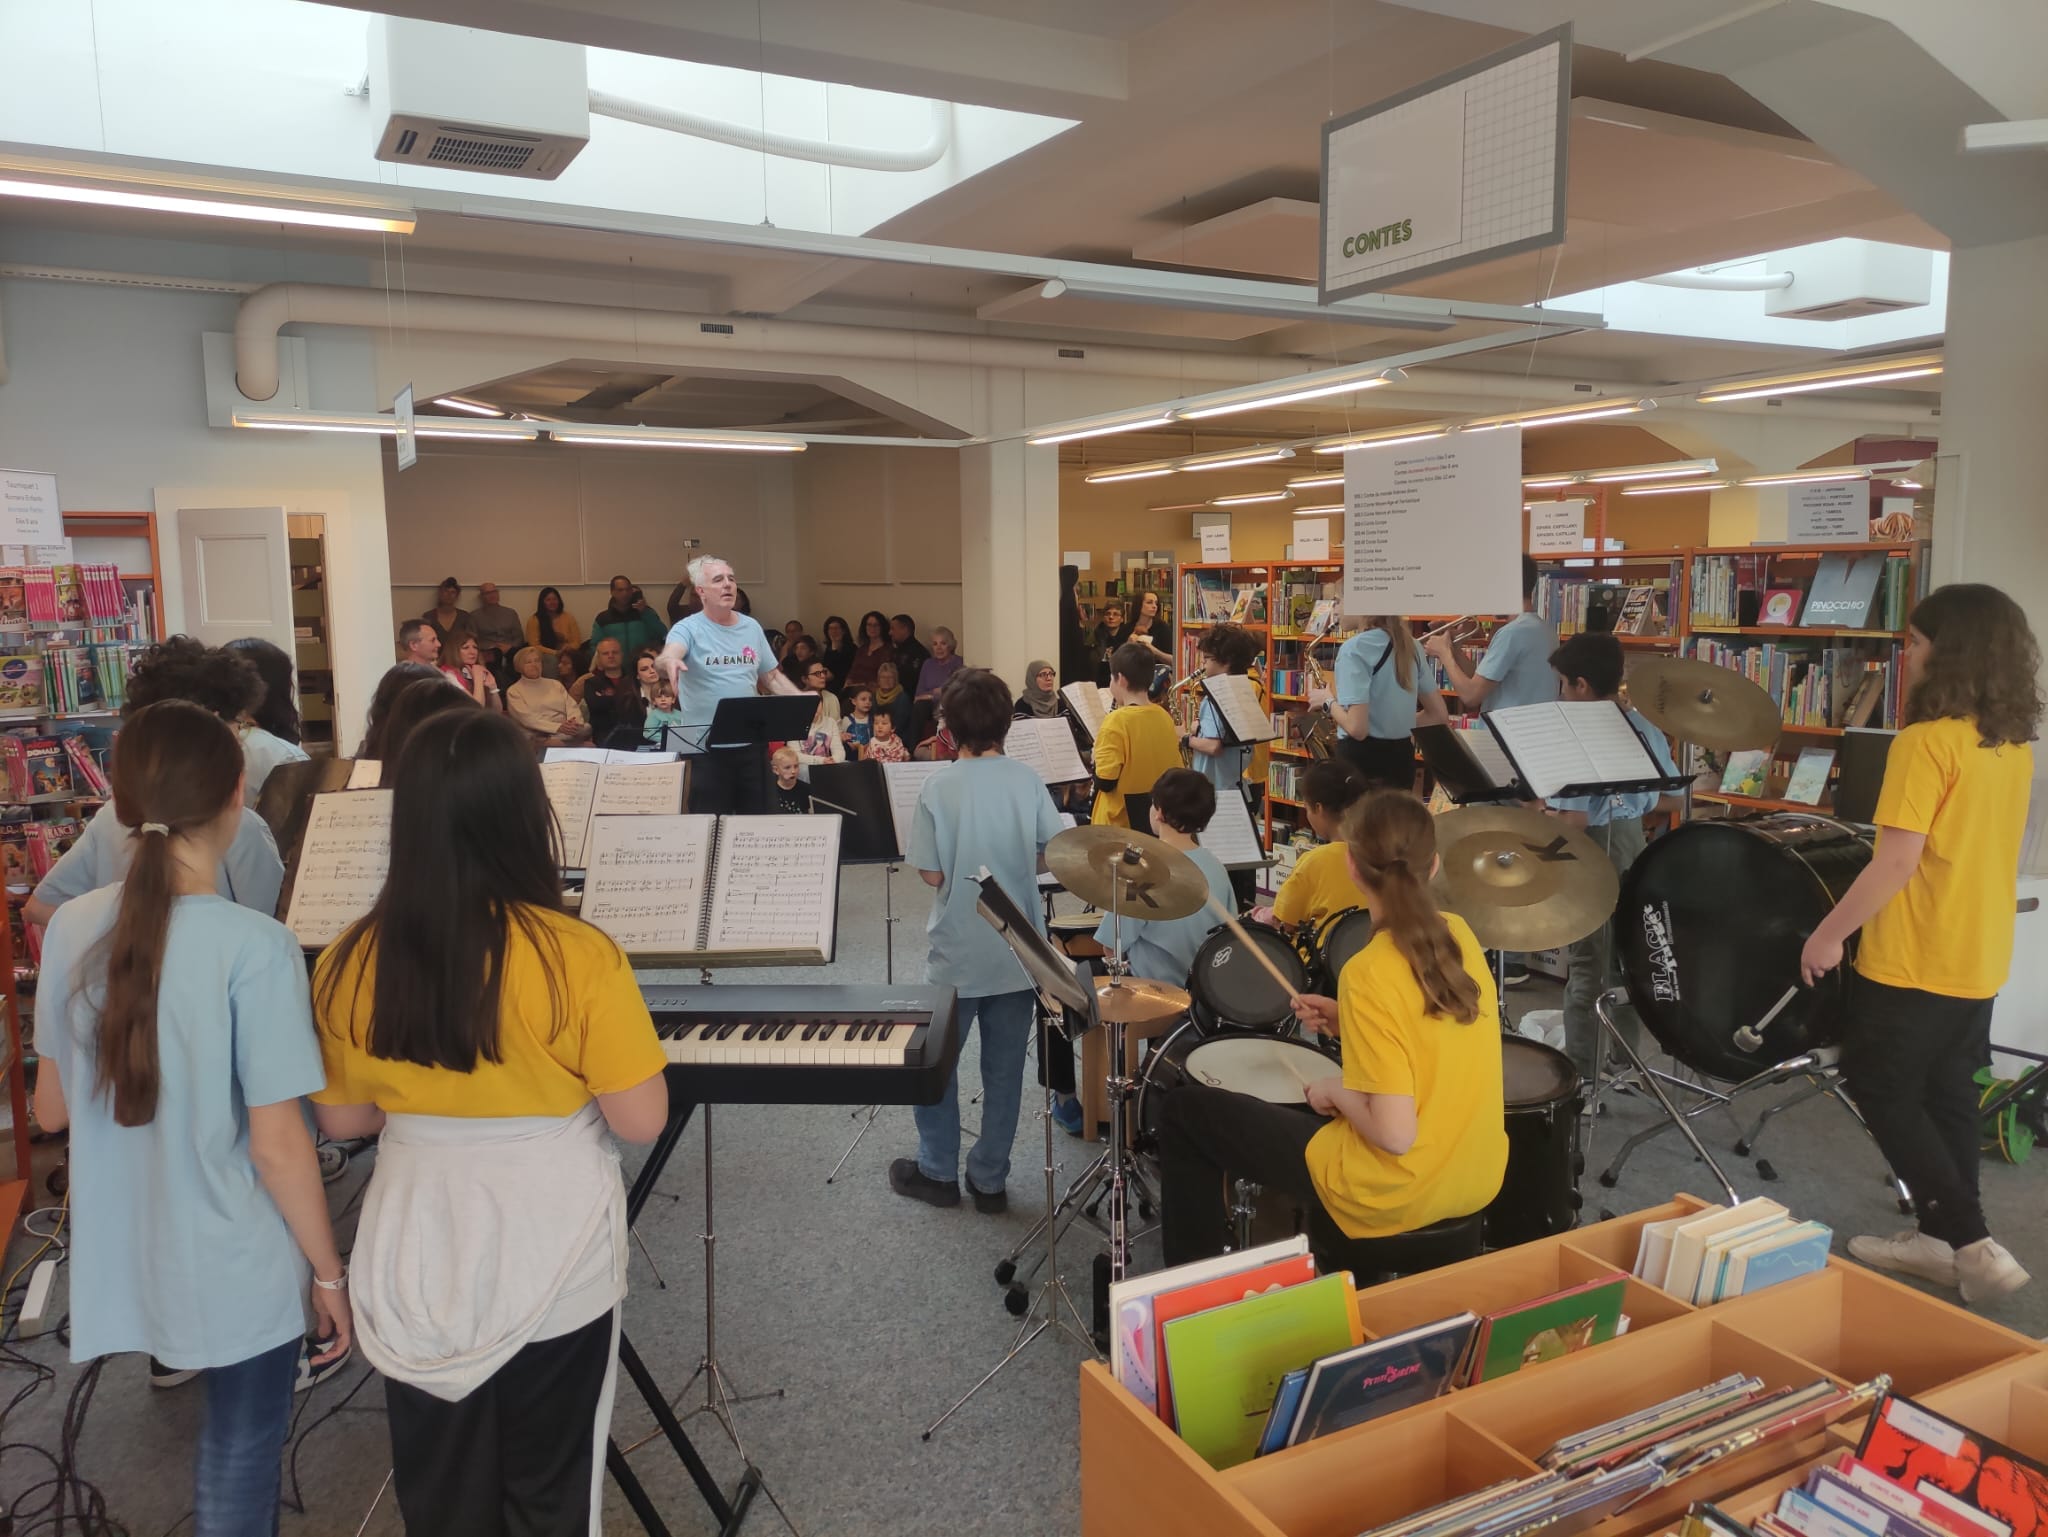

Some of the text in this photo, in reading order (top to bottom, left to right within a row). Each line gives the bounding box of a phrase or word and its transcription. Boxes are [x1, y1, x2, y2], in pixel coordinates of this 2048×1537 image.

[1342, 218, 1413, 258] CONTES
[1811, 600, 1865, 610] PINOCCHIO
[705, 655, 754, 665] LA BANDA
[27, 746, 61, 758] DONALD
[1521, 834, 1579, 862] K
[1125, 881, 1160, 908] K
[1643, 911, 1674, 1001] BLACK
